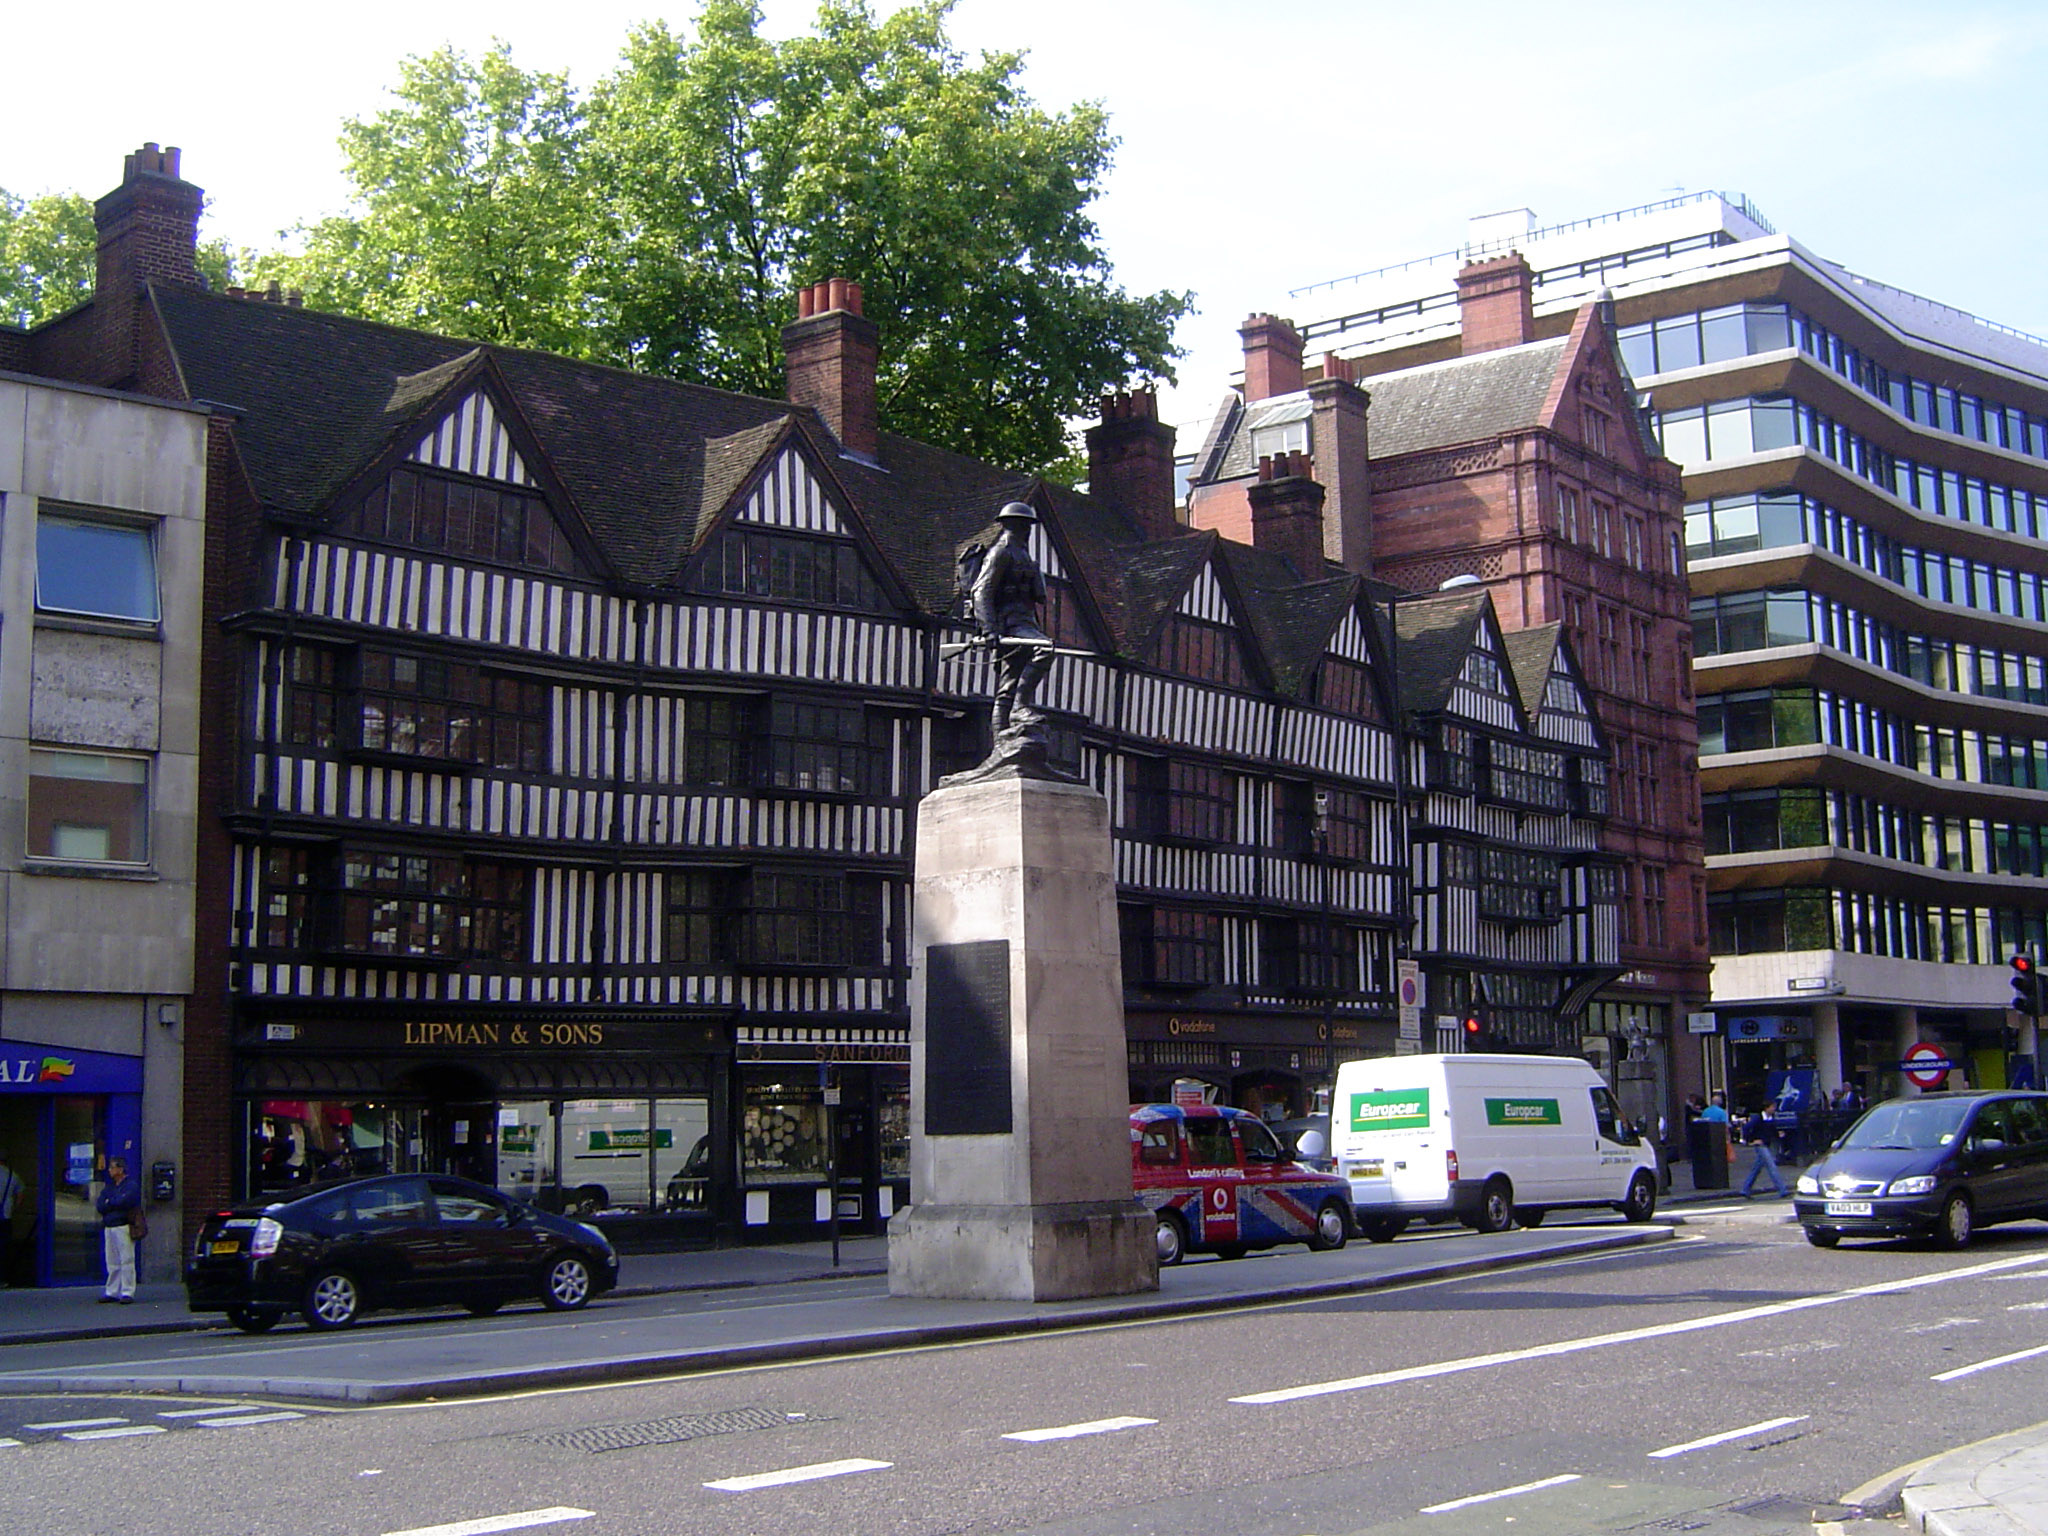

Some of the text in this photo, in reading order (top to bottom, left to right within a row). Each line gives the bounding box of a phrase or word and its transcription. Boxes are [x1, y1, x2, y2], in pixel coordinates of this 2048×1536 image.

[405, 1023, 603, 1045] LIPMAN & SONS
[1180, 1020, 1216, 1034] vodafone
[751, 1044, 908, 1061] 3 SANFORD
[1901, 1060, 1950, 1069] UNDERGROUND
[1360, 1103, 1420, 1118] Europcar
[1504, 1103, 1544, 1120] Europcar
[1206, 1211, 1236, 1221] vodafone
